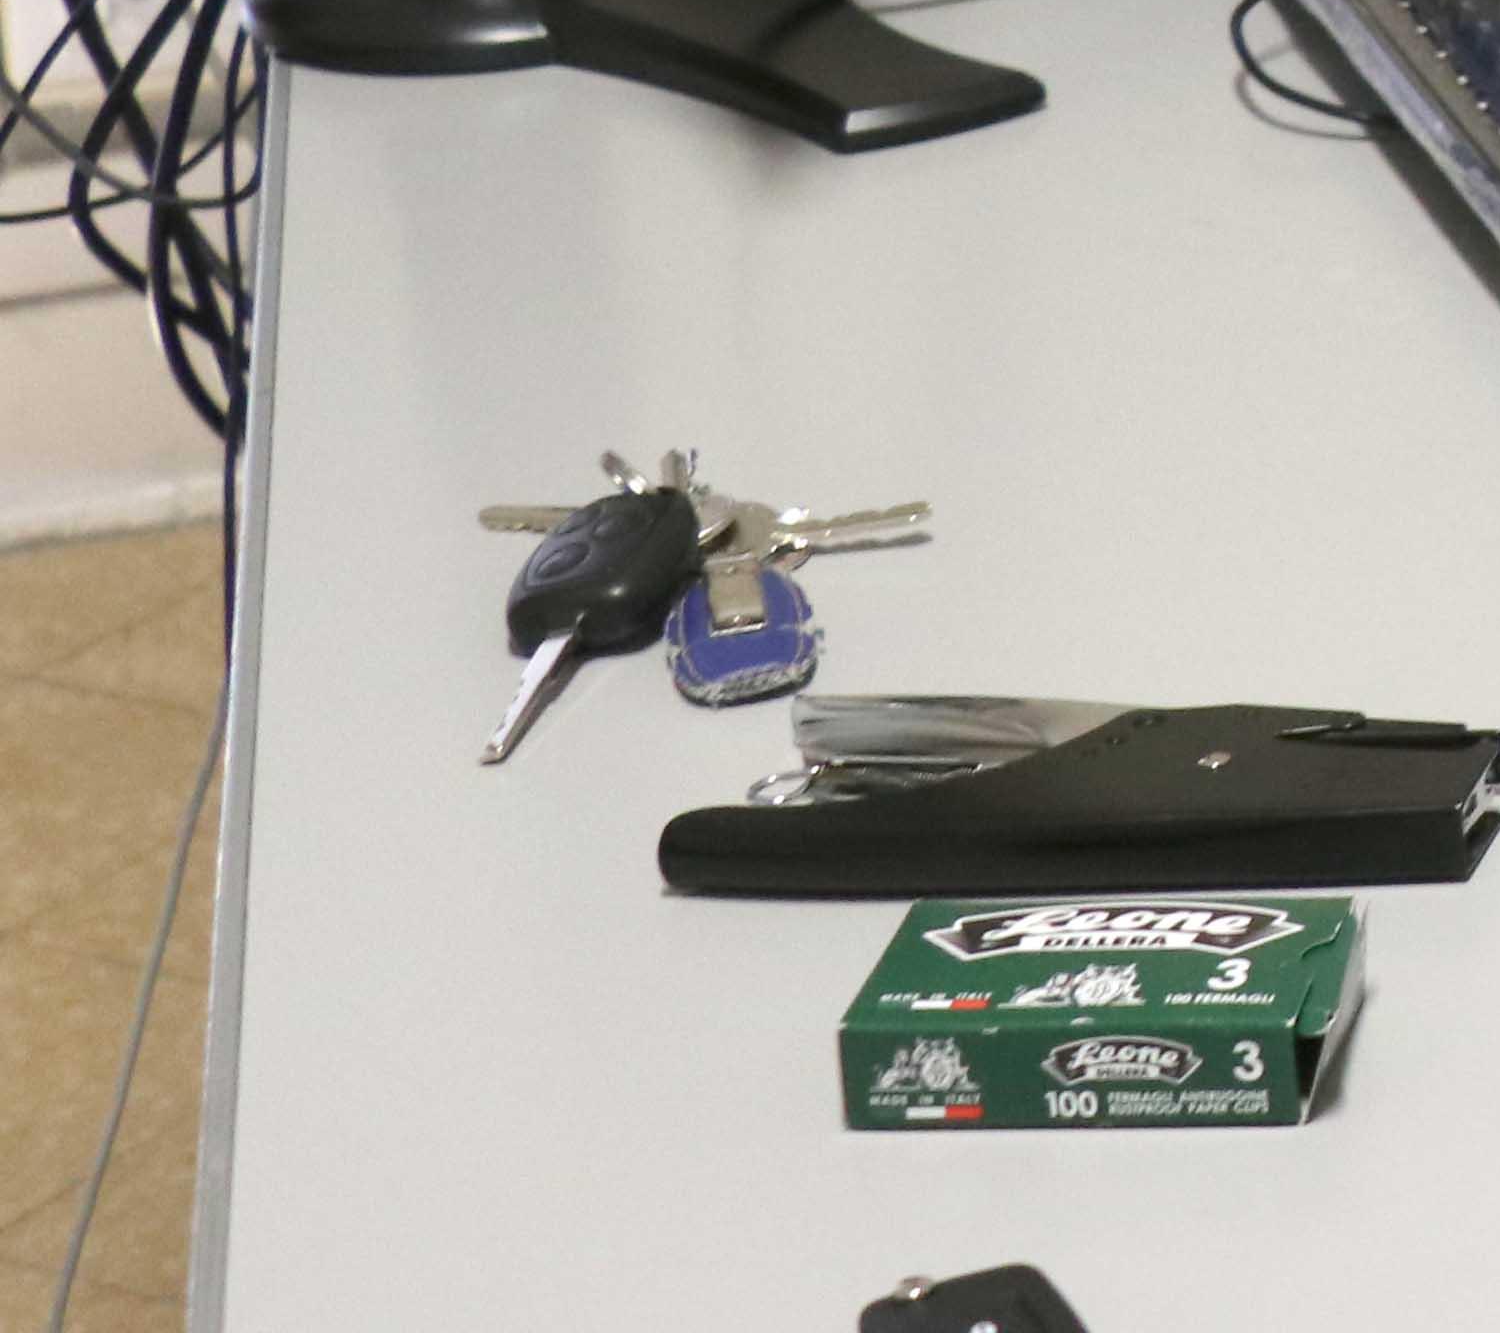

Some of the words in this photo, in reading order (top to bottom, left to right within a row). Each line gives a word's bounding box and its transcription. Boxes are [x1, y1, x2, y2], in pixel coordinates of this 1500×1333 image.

[980, 907, 1253, 942] Leone
[1042, 934, 1167, 948] DELLERA
[1206, 957, 1252, 992] 3
[1163, 993, 1192, 1006] 100
[1193, 992, 1276, 1006] FERMAGLI
[1066, 1040, 1180, 1070] Leone
[1232, 1039, 1265, 1083] 3
[1044, 1090, 1098, 1119] 100
